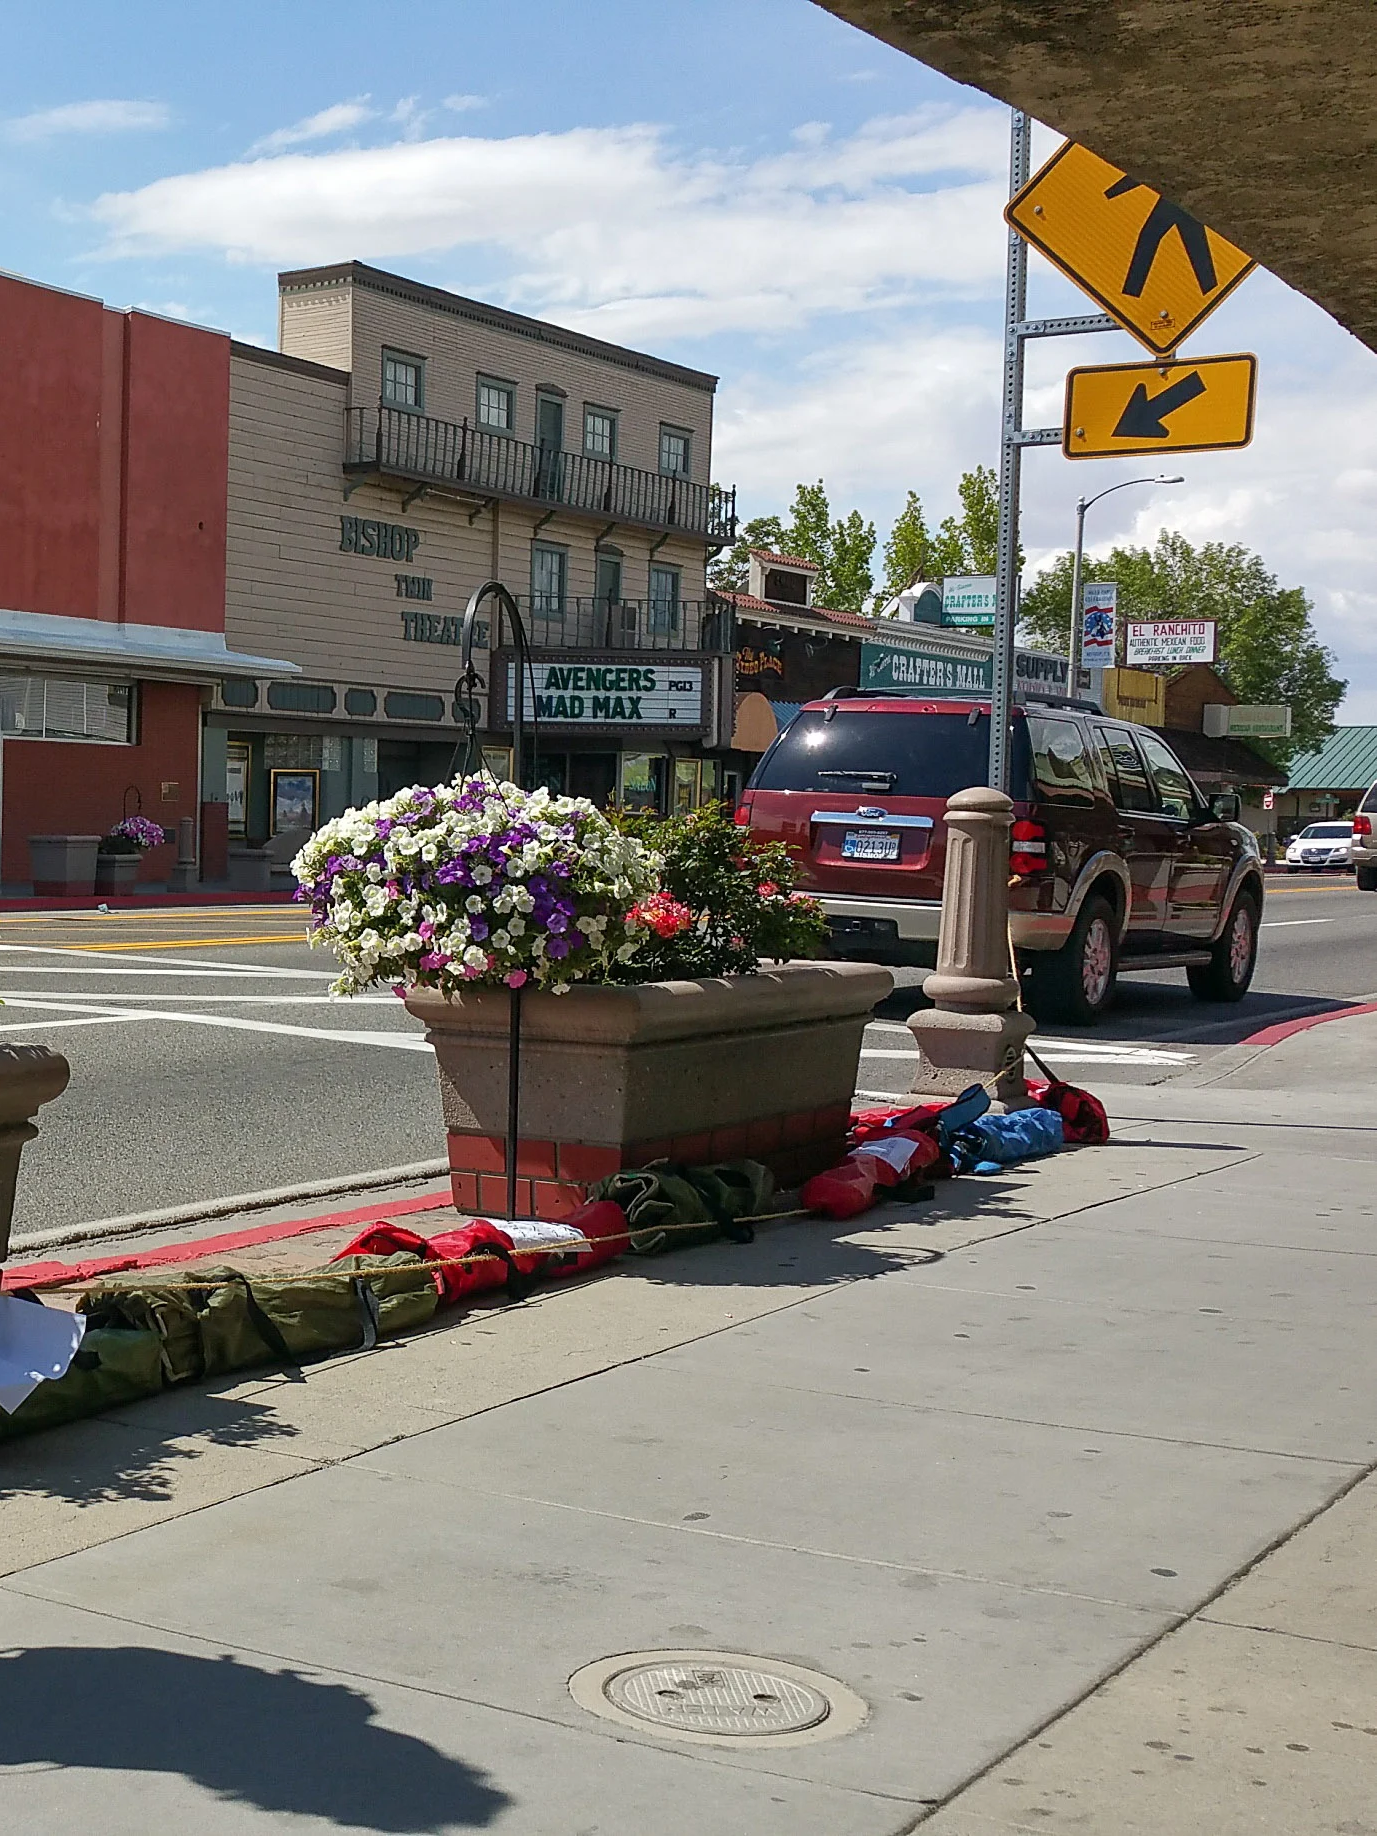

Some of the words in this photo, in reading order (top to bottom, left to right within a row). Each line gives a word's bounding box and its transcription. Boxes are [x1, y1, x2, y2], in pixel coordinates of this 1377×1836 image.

[340, 515, 420, 562] BISHOP
[395, 573, 433, 601] TWIN
[945, 594, 989, 608] CRAFTER'S
[1130, 638, 1158, 647] AUTHENTIC
[1162, 637, 1186, 646] MEXICAN
[1132, 625, 1144, 637] EL
[1153, 623, 1205, 636] RANCHITO
[544, 667, 656, 692] AVENGERS
[892, 654, 953, 687] CRAFTER'S
[956, 664, 985, 688] MALL
[1016, 654, 1069, 684] SUPPLY
[669, 681, 693, 692] PG13
[535, 694, 584, 718] MAD
[593, 696, 643, 719] MAX
[669, 708, 677, 719] R
